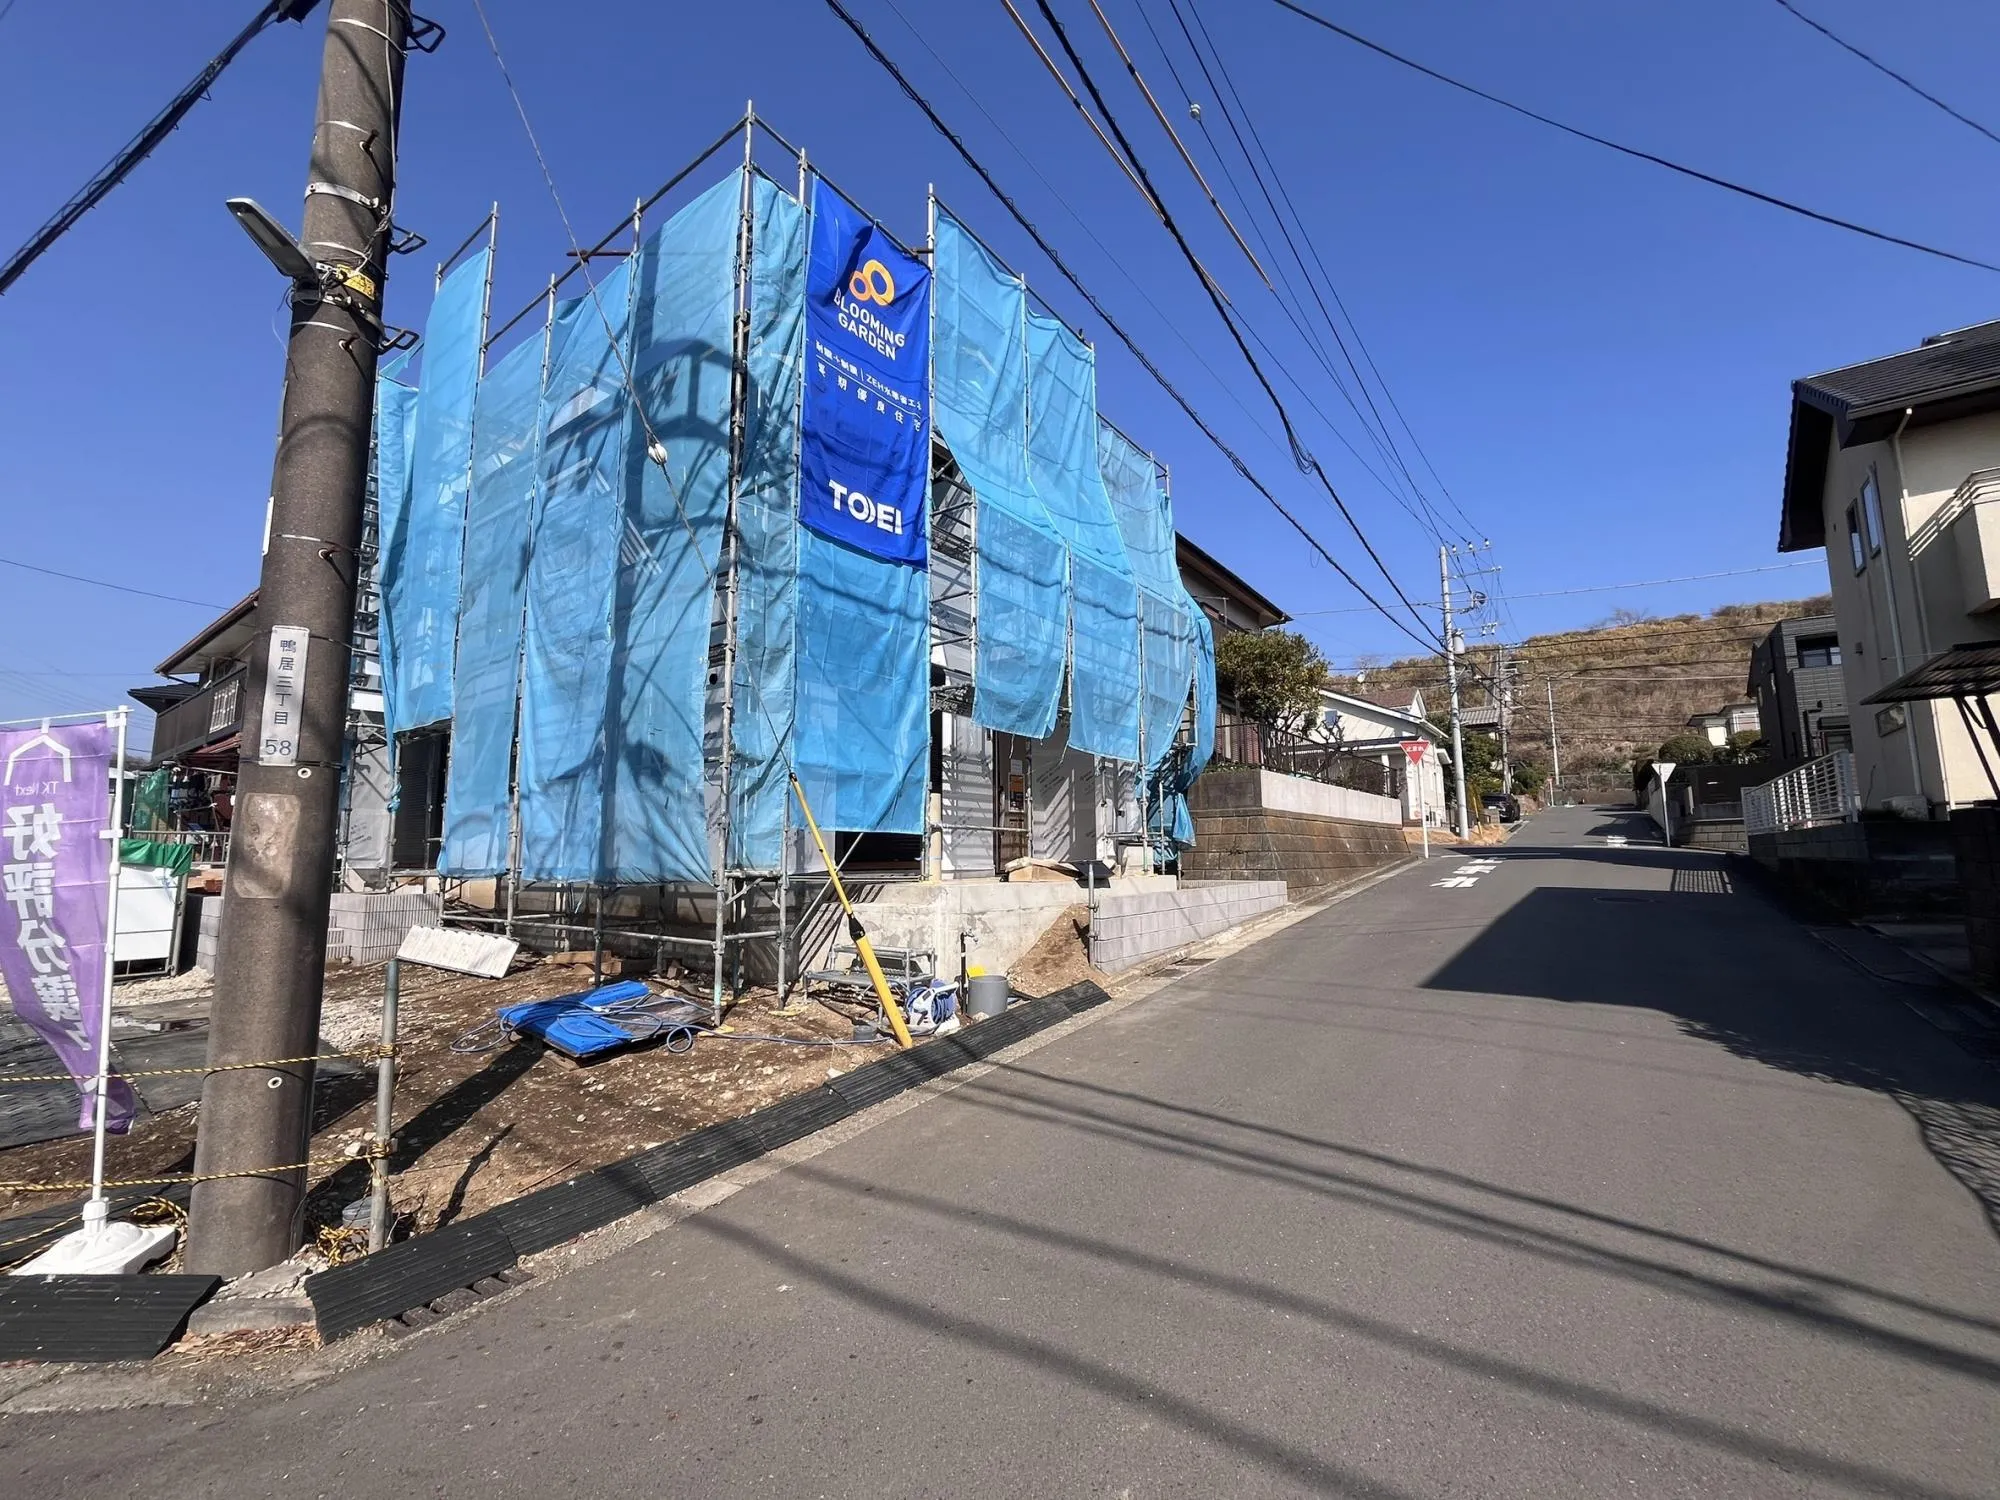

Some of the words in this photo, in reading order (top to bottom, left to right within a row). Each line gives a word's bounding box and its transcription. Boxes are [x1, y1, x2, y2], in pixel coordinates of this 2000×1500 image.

[834, 287, 905, 348] BLOOMING
[838, 312, 896, 361] GARDEN
[828, 479, 903, 535] TOEI
[274, 640, 297, 727] 鴨居三丁目
[265, 739, 292, 756] 58
